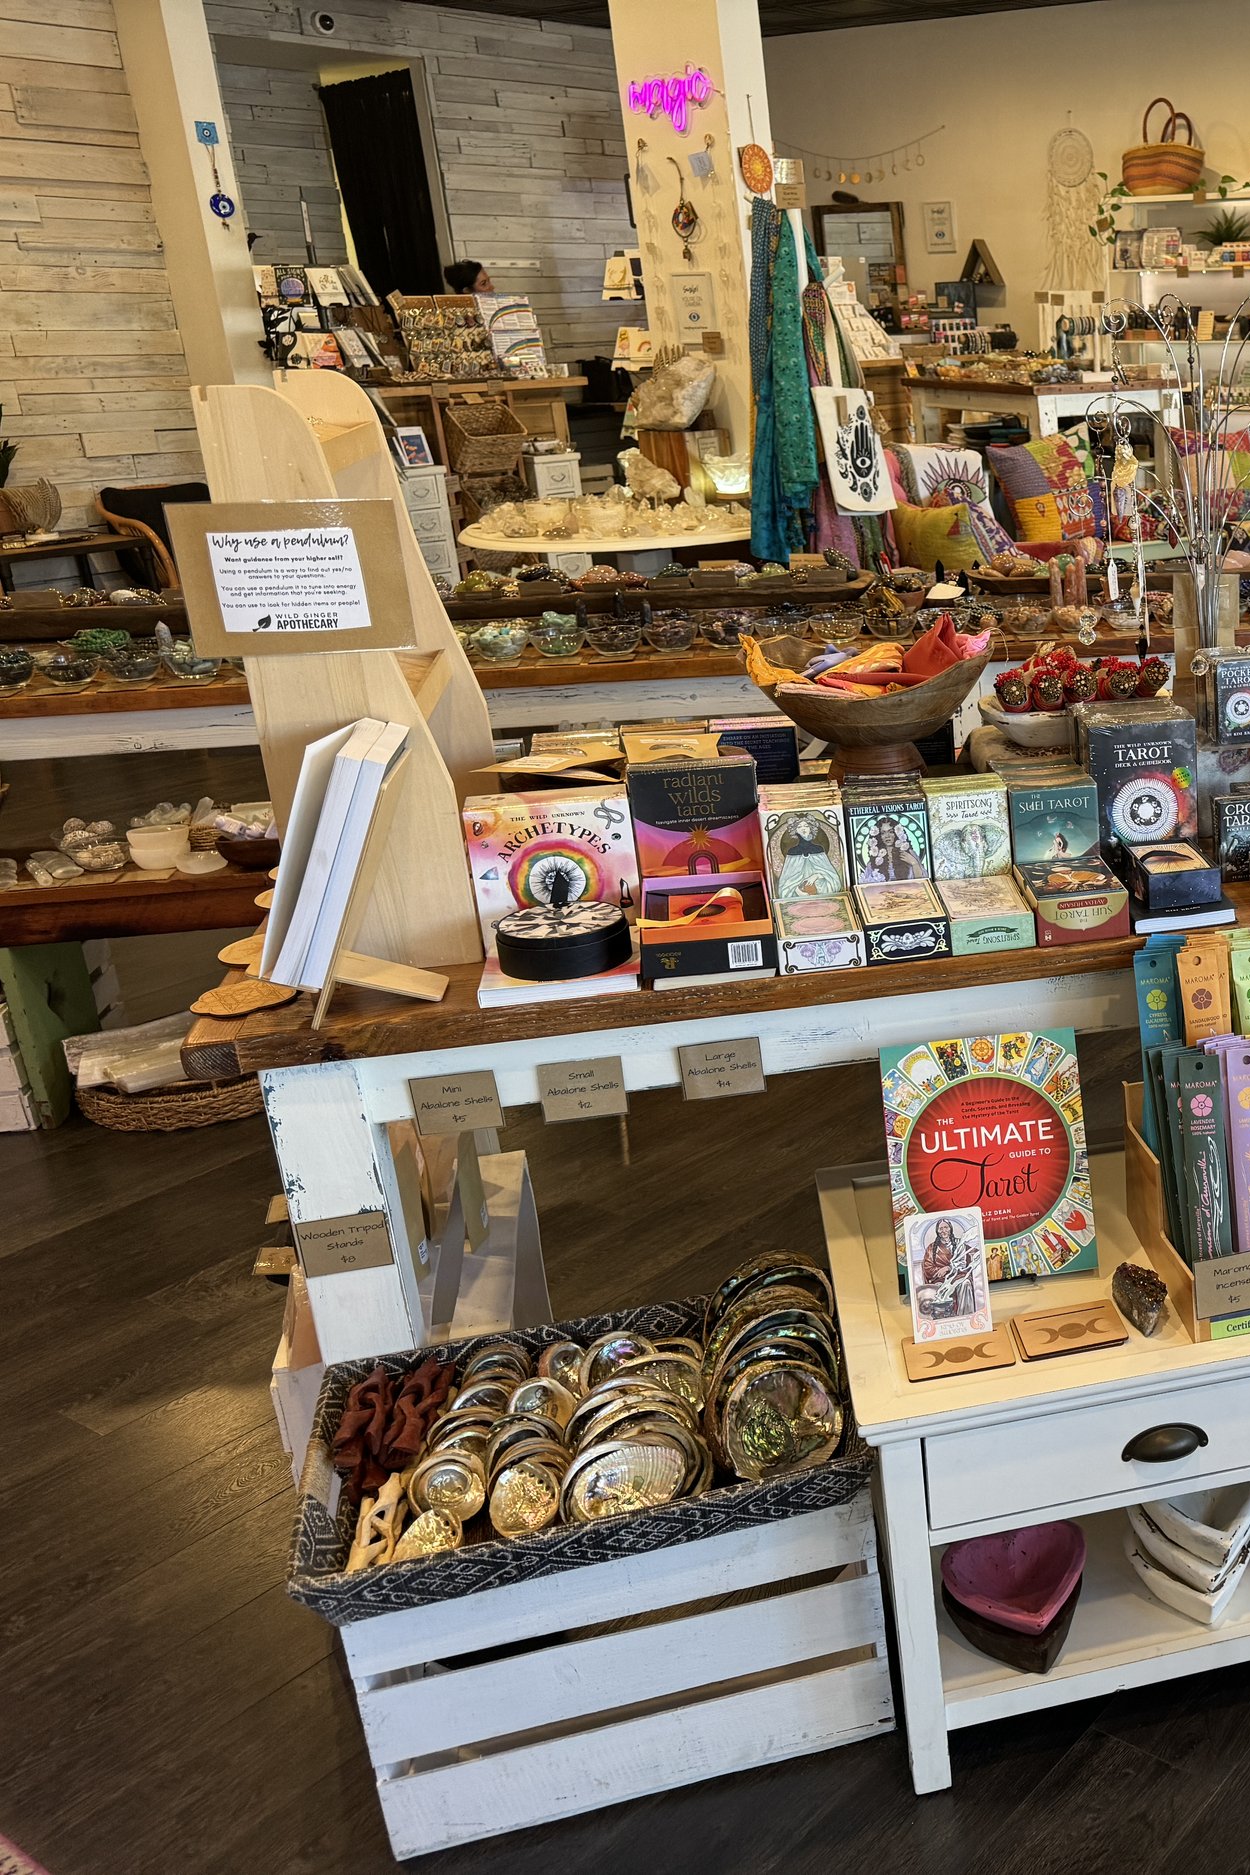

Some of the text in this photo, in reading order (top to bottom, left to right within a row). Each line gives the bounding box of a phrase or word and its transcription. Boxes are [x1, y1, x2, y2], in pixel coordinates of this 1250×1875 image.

[629, 65, 711, 132] magic
[276, 268, 304, 277] ALL SIGNS
[212, 534, 242, 552] Why
[244, 537, 268, 548] use
[284, 533, 349, 550] pendulum?
[277, 619, 339, 630] APOTHECARY
[1114, 746, 1172, 762] TAROT
[1138, 758, 1172, 767] GUIDEBOOK
[663, 772, 724, 789] radiant
[668, 787, 721, 805] wilds
[849, 803, 925, 815] ETHEREAL VISIONS TAROT
[946, 798, 992, 810] SPIRITSONG
[1048, 796, 1090, 810] TAROT
[551, 811, 586, 819] UNKNOWN
[677, 803, 716, 817] tarot
[961, 810, 979, 818] Tarot
[497, 822, 612, 864] ARCHETYPES
[1055, 905, 1113, 921] SUFI TAROT
[1140, 977, 1169, 985] MAROMA
[1185, 975, 1213, 985] MAROMA
[1189, 1016, 1221, 1024] SANDALWOOD
[705, 1051, 736, 1063] Large
[568, 1070, 595, 1080] Small
[687, 1061, 757, 1077] Abalone Shells
[442, 1085, 462, 1095] Mini
[547, 1081, 620, 1097] Abalone Shells
[716, 1079, 732, 1089] $14
[1185, 1081, 1216, 1089] MAROMA
[420, 1095, 494, 1111] Abalone Shells
[577, 1101, 593, 1110] $12
[452, 1114, 467, 1124] $5
[937, 1117, 955, 1126] THE
[920, 1119, 1055, 1155] ULTIMATE
[1009, 1147, 1051, 1159] GUIDE TO
[929, 1153, 1040, 1209] Tarot
[994, 1208, 1012, 1216] DEAN
[301, 1221, 384, 1241] Wooden Tripod
[327, 1238, 364, 1251] Stands
[341, 1255, 357, 1263] $8
[1228, 1293, 1241, 1304] $5
